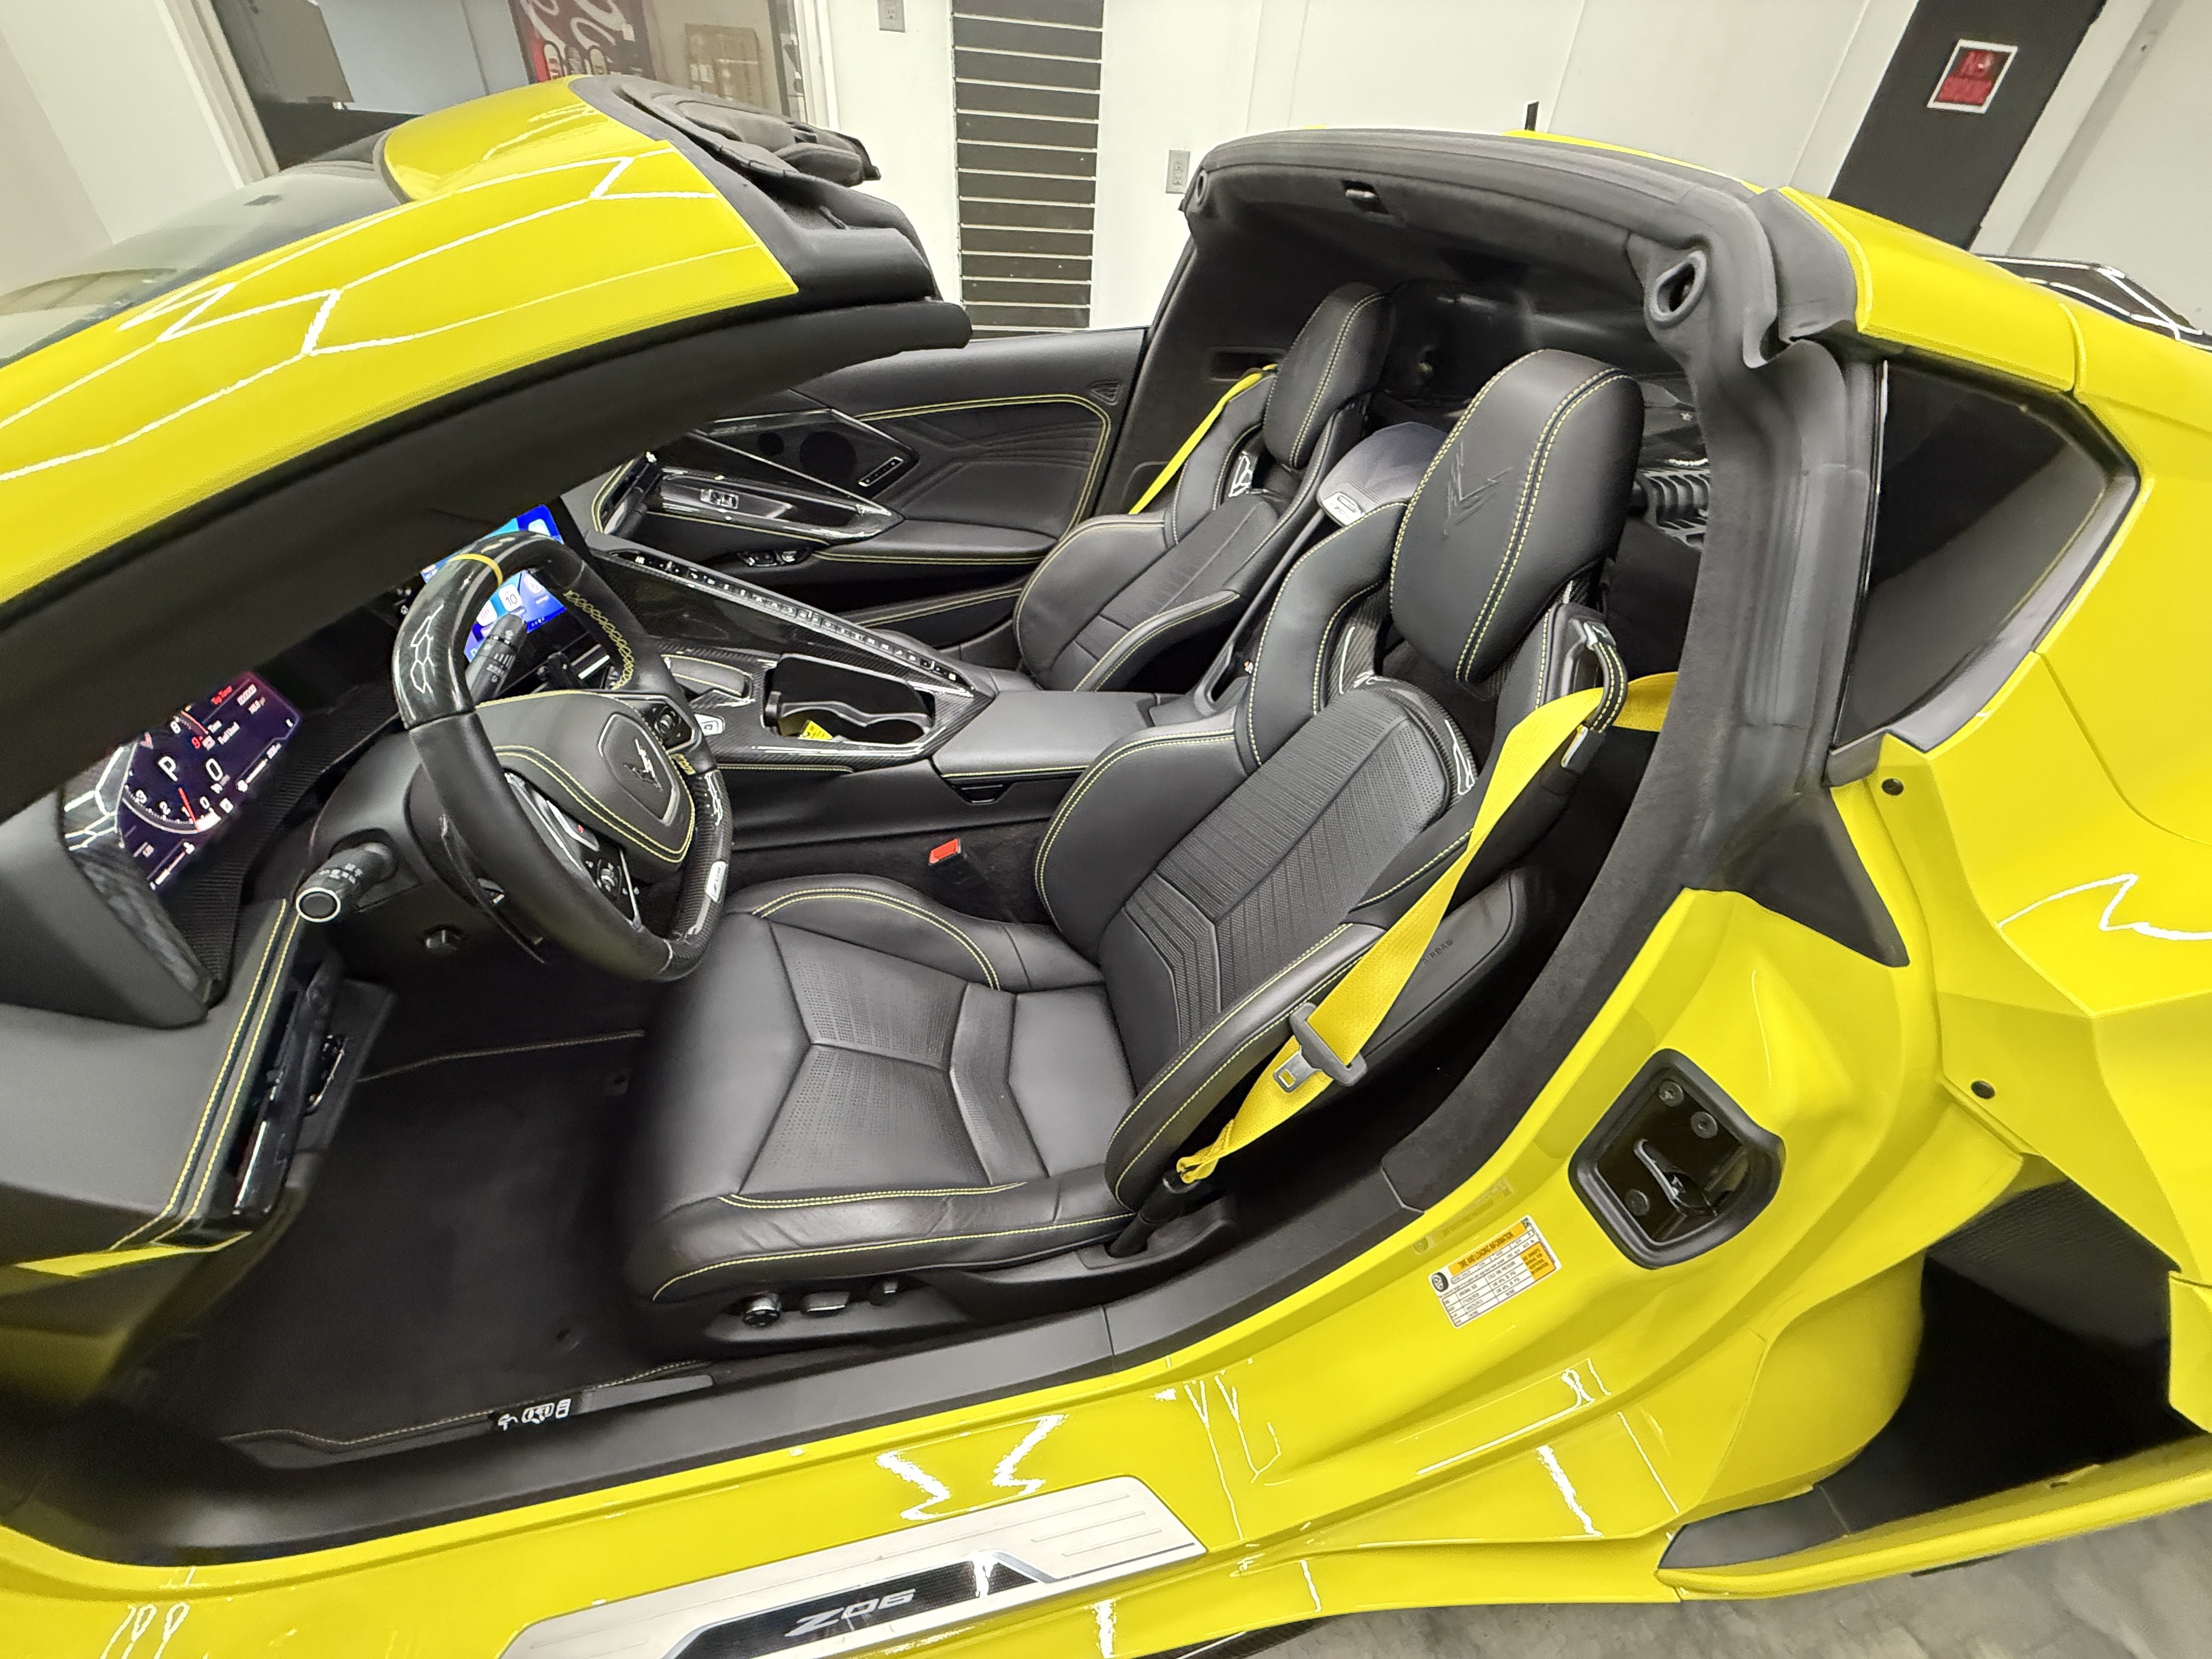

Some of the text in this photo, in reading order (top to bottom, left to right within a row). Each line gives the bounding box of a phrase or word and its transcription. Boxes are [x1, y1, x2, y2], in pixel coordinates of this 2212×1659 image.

[505, 594, 518, 606] 10
[170, 721, 182, 734] 8
[158, 756, 178, 782] P
[205, 758, 223, 781] 0
[136, 789, 148, 804] 3
[199, 795, 210, 809] 0
[159, 801, 171, 815] 2
[785, 1588, 916, 1637] Z06
